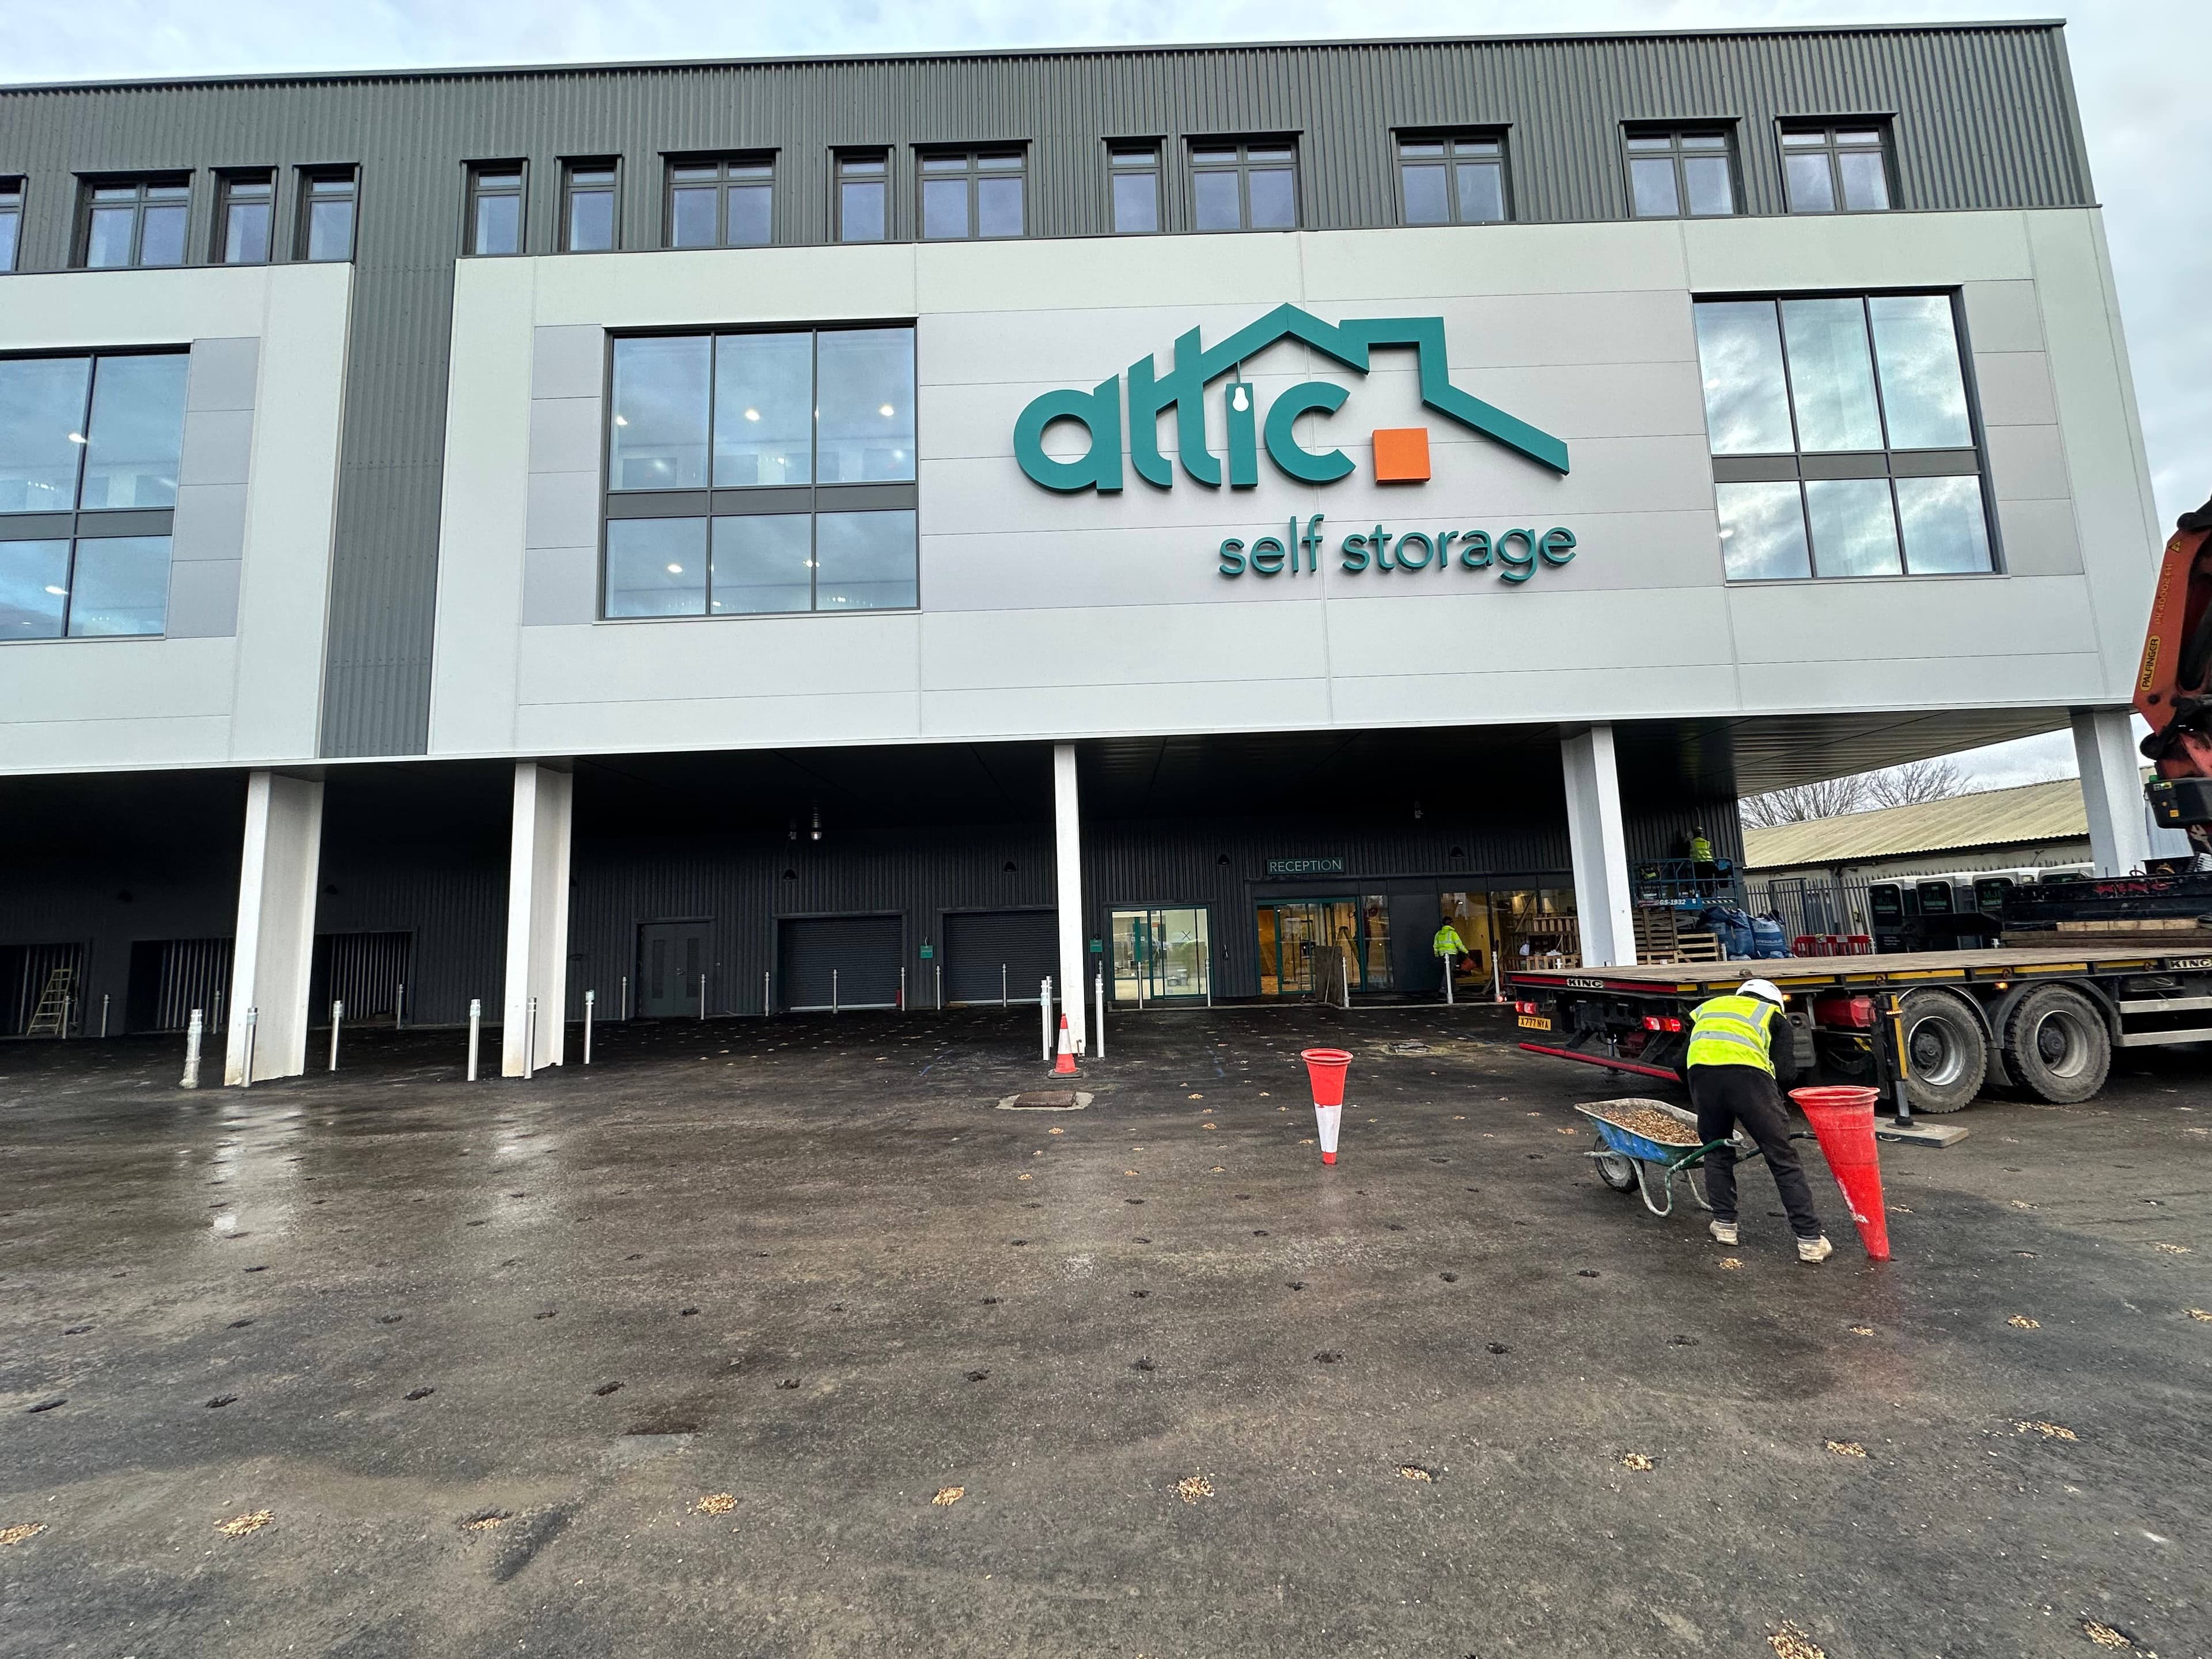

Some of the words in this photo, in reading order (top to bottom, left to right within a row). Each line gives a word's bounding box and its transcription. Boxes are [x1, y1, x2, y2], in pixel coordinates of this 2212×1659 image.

[1013, 324, 1357, 493] attic
[1219, 514, 1324, 575] self
[1342, 524, 1577, 584] storage
[2141, 638, 2159, 688] PALFINGER
[1269, 859, 1342, 873] RECEPTION
[1520, 1017, 1536, 1027] X777
[1536, 1019, 1549, 1029] NYA
